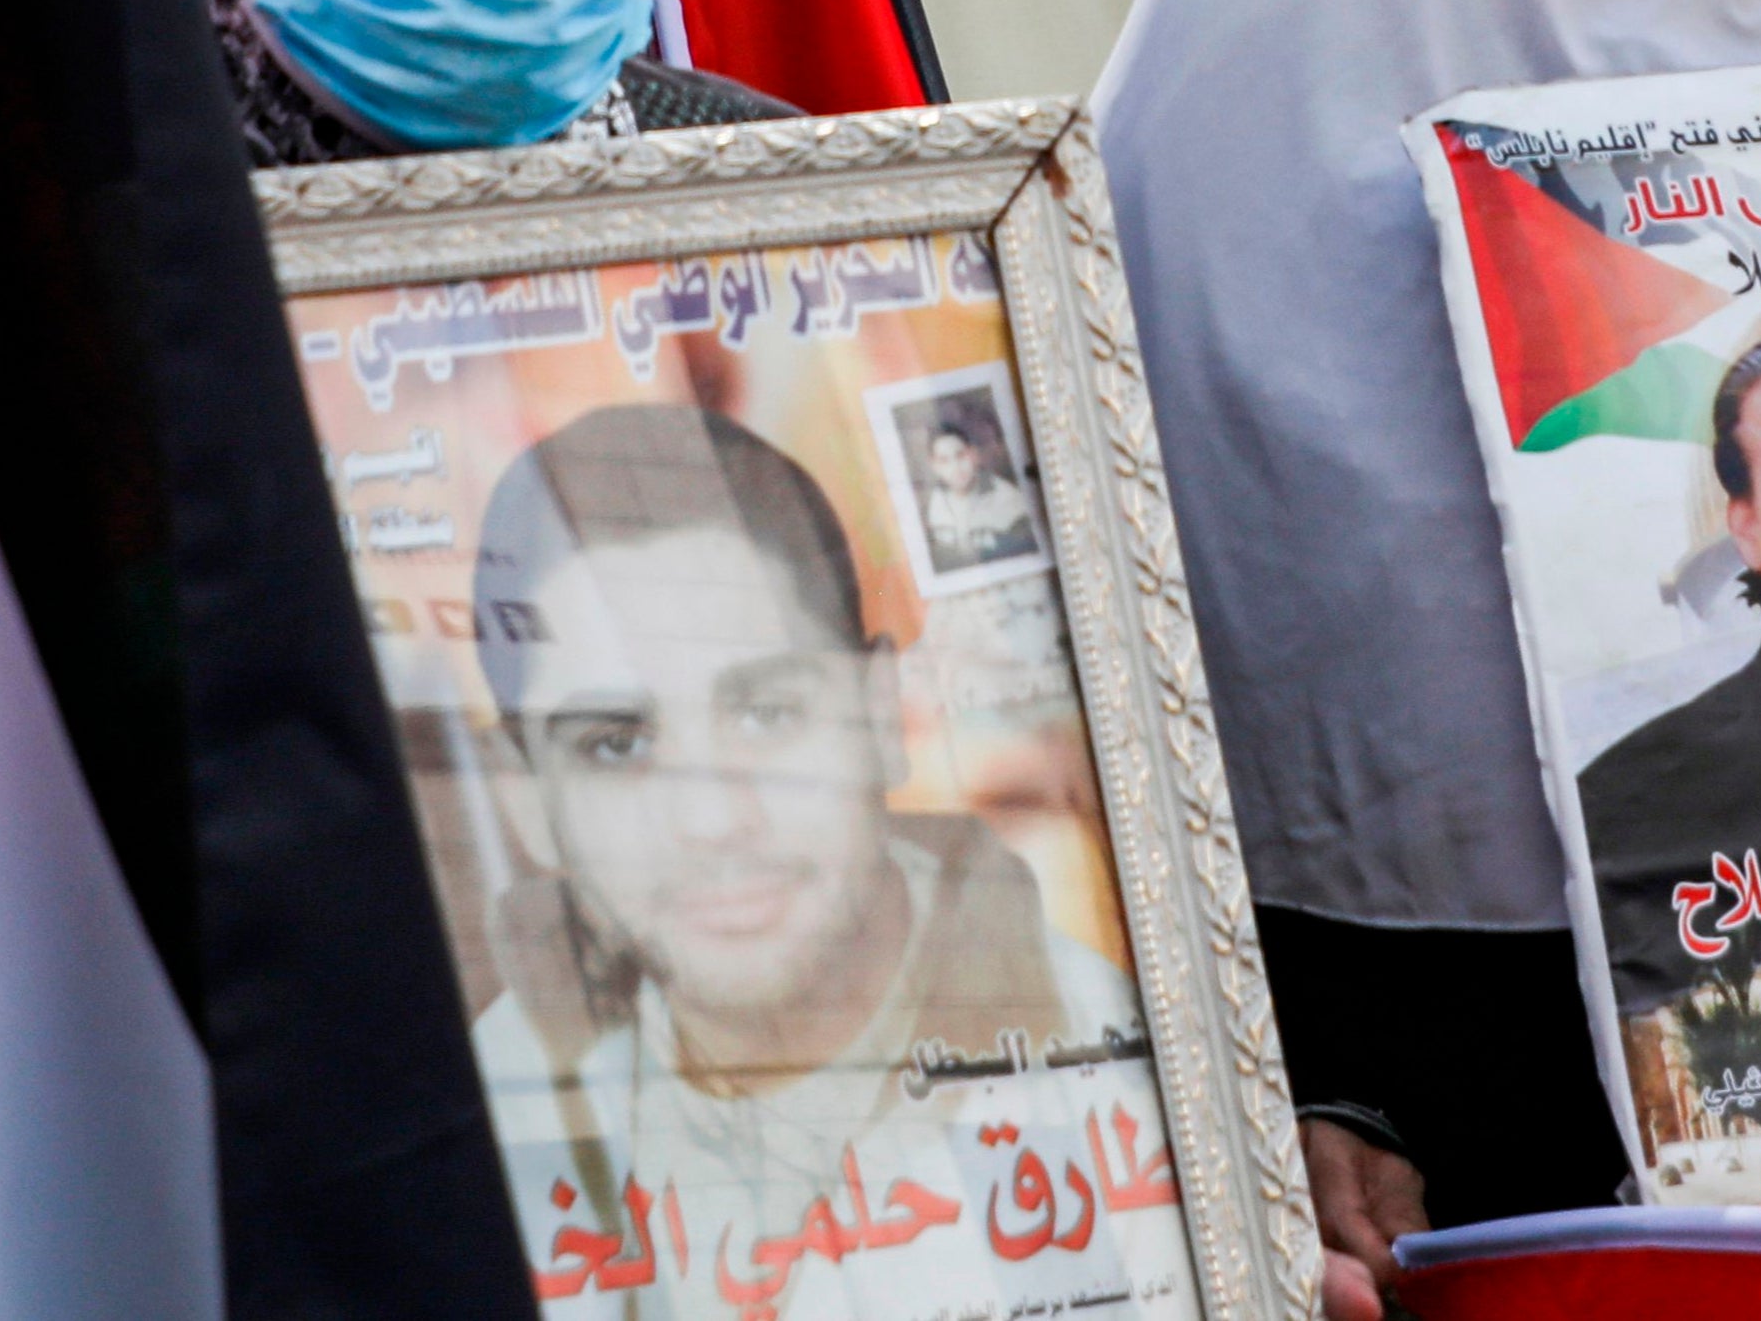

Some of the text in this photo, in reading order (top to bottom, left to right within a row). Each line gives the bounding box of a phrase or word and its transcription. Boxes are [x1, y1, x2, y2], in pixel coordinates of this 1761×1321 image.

[1670, 119, 1720, 153] فتح
[1624, 176, 1725, 234] النار
[716, 1140, 961, 1321] حلمي
